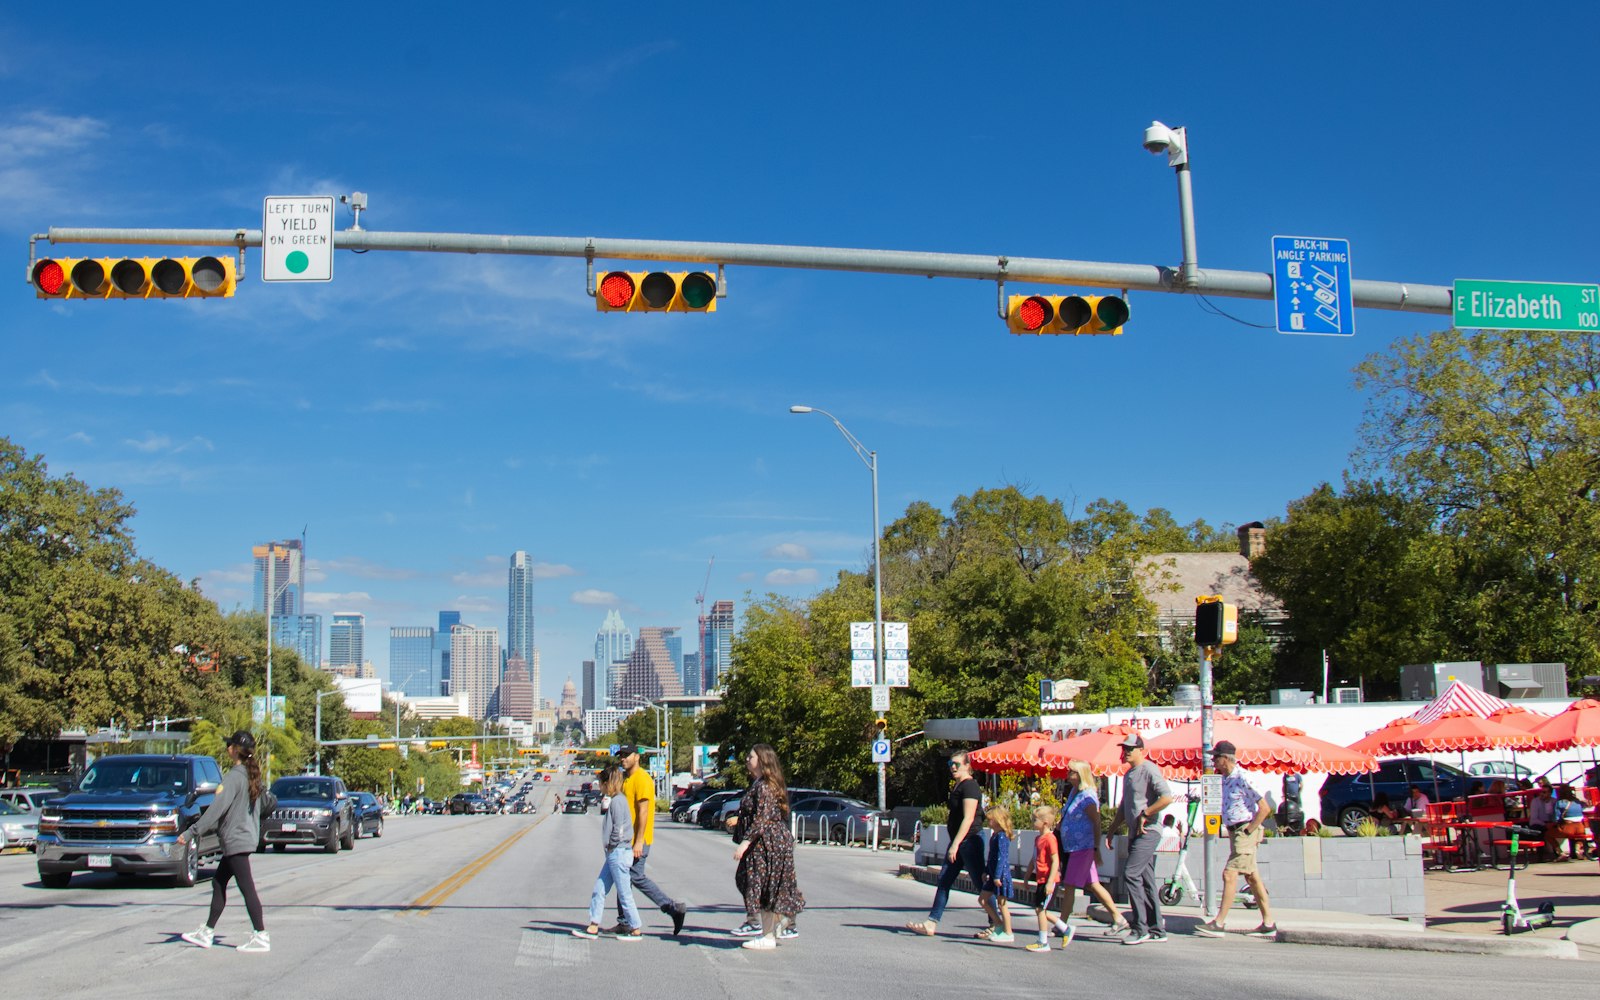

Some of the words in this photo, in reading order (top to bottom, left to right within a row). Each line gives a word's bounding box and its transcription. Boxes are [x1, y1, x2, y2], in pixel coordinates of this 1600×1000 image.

[269, 204, 294, 213] LEFT
[302, 204, 329, 213] TURN
[281, 218, 317, 230] YIELD
[270, 235, 284, 245] ON
[292, 235, 326, 245] GREEN
[1293, 239, 1329, 250] BACK-IN
[1277, 250, 1305, 261] ANGLE
[1309, 251, 1347, 263] PARKING
[1290, 266, 1297, 275] 2
[1319, 291, 1331, 301] 3
[1457, 296, 1465, 311] E
[1471, 290, 1562, 320] Elizabeth
[1581, 289, 1596, 304] ST
[1577, 312, 1598, 327] 100
[1040, 701, 1075, 710] PATIO
[1121, 718, 1150, 730] BEER
[1154, 719, 1161, 728] &
[877, 743, 887, 754] P
